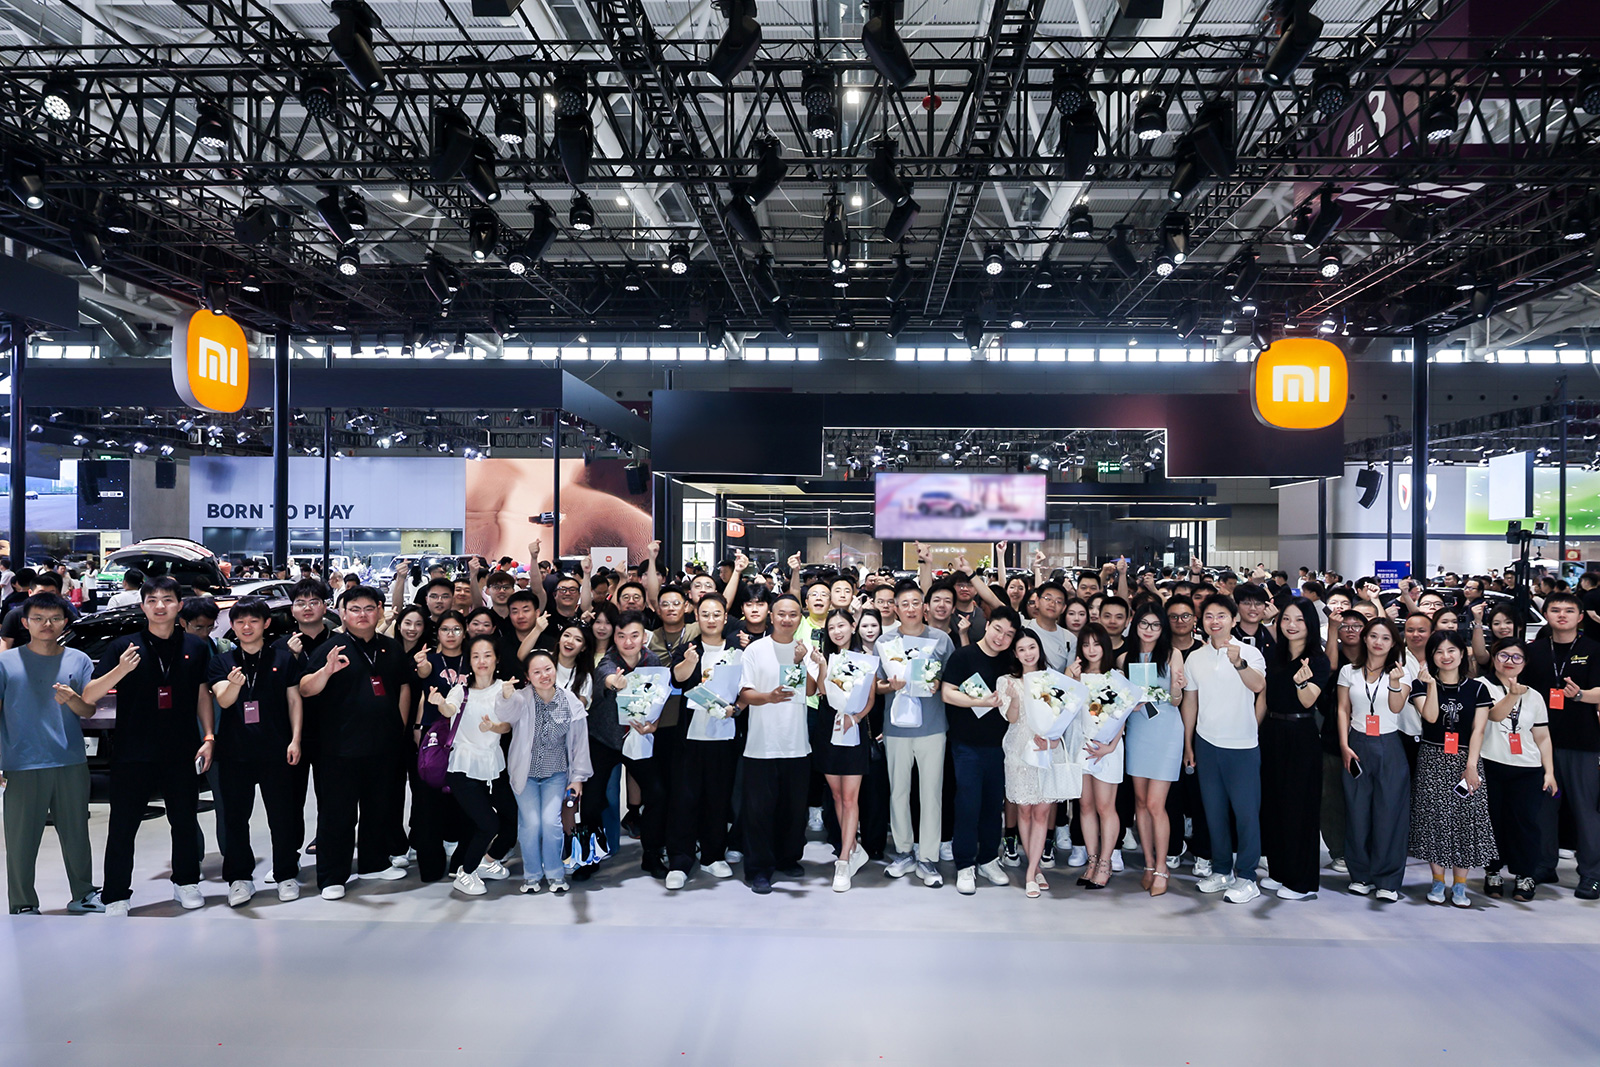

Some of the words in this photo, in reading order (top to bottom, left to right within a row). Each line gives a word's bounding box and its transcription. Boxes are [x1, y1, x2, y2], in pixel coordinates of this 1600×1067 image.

[1346, 123, 1364, 151] 展厅
[207, 503, 263, 519] BORN
[304, 504, 355, 520] PLAY
